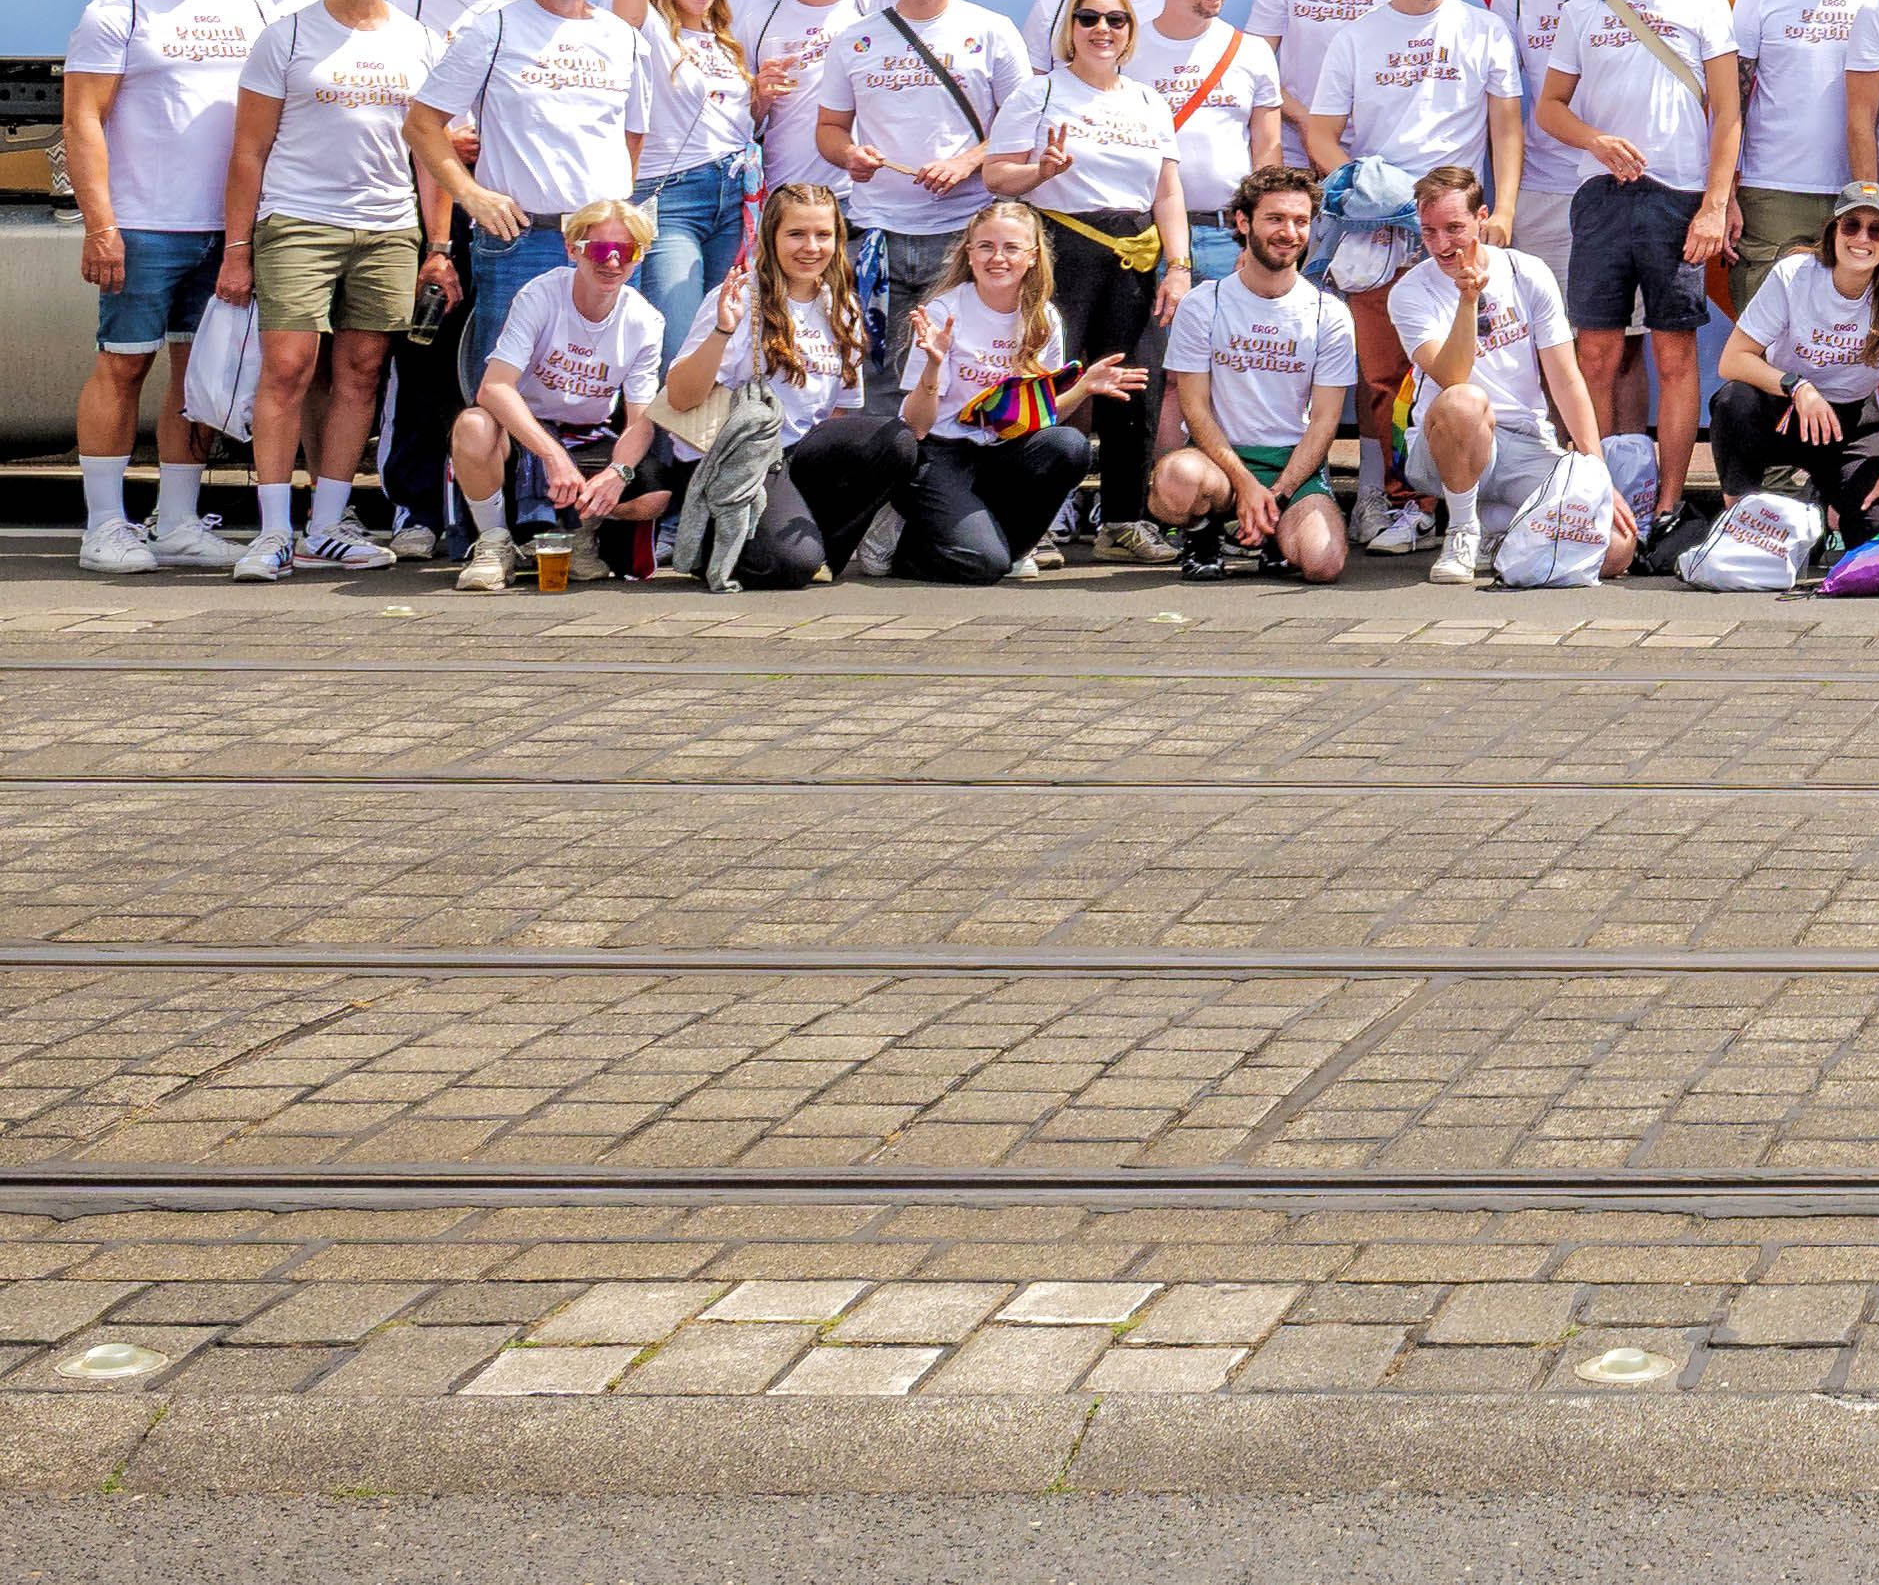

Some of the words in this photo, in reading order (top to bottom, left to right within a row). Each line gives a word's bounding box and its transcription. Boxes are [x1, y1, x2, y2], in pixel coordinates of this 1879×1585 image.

[1822, 0, 1846, 7] ERGO
[1408, 39, 1433, 47] ERGO
[1252, 324, 1278, 335] ERGO
[1834, 323, 1858, 332] ERGO
[992, 340, 1017, 348] ERGO
[567, 342, 592, 357] ERGO
